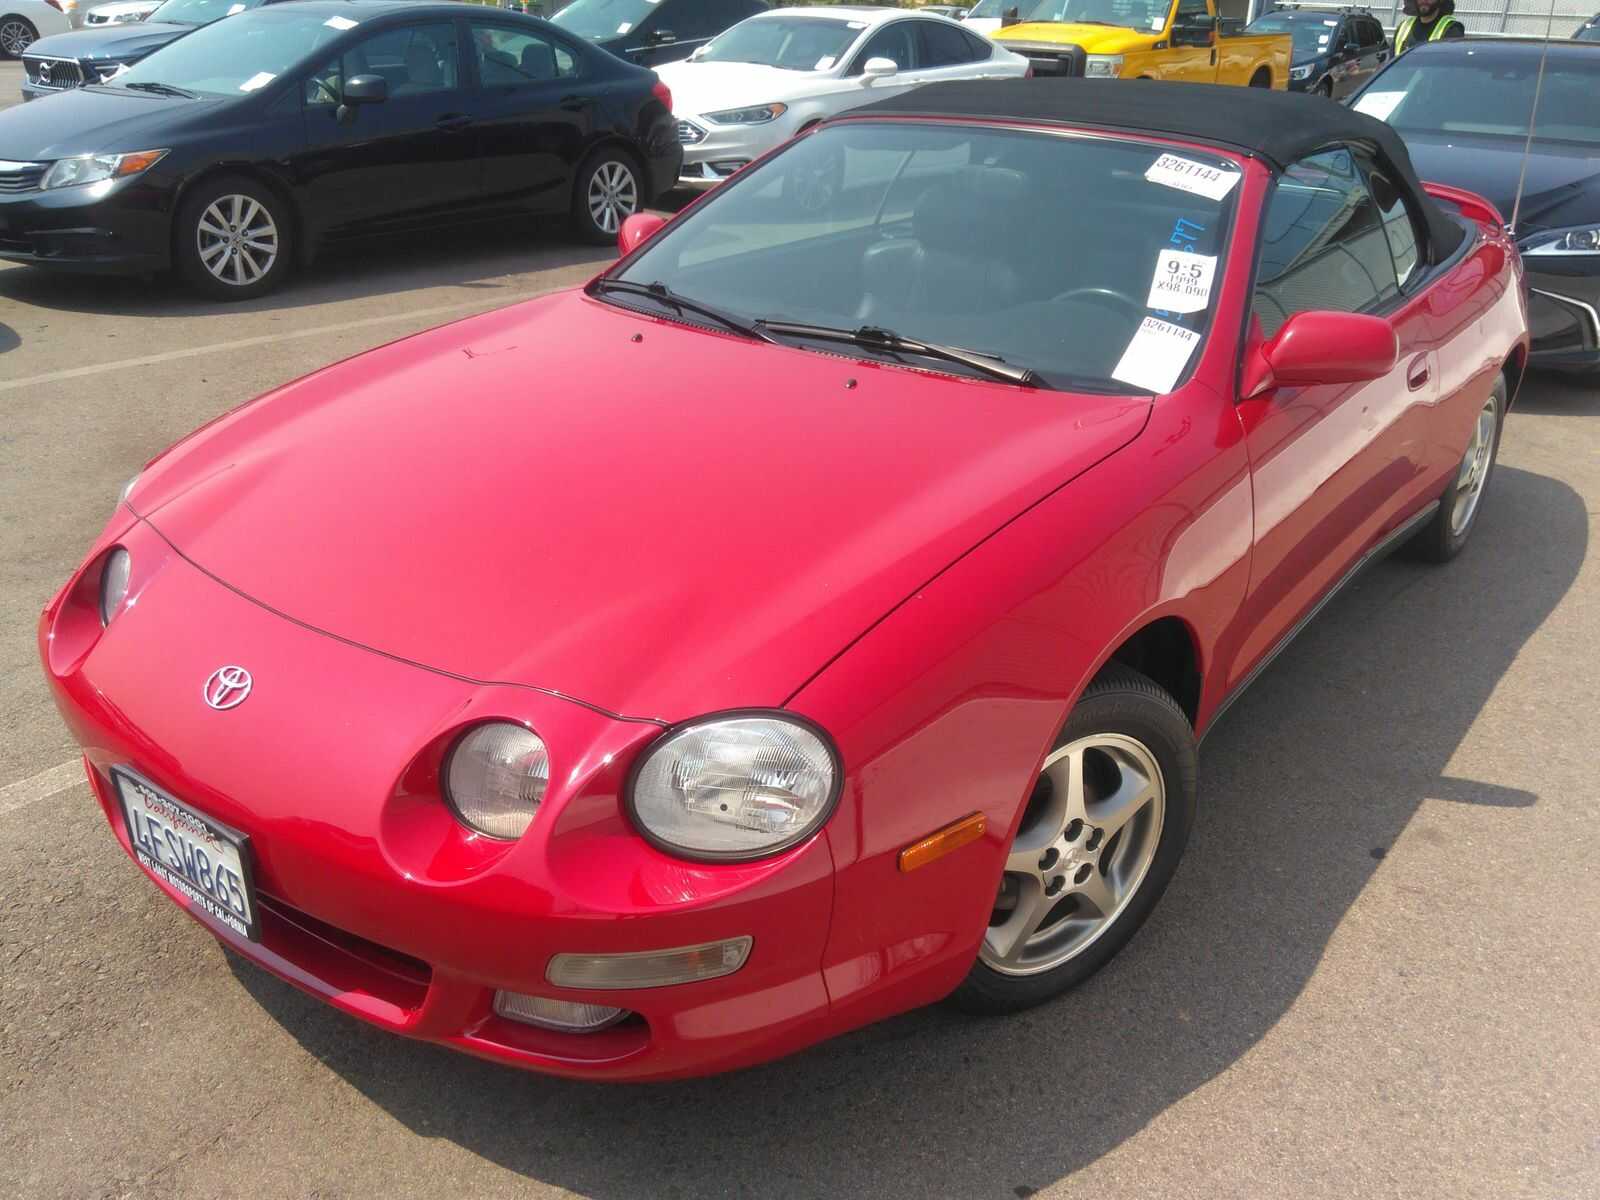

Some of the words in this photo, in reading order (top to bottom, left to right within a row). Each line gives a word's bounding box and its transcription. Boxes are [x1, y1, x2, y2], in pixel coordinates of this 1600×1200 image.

[1157, 157, 1221, 181] 3261144
[1143, 318, 1193, 341] 3261144
[132, 806, 247, 918] 4FSW865
